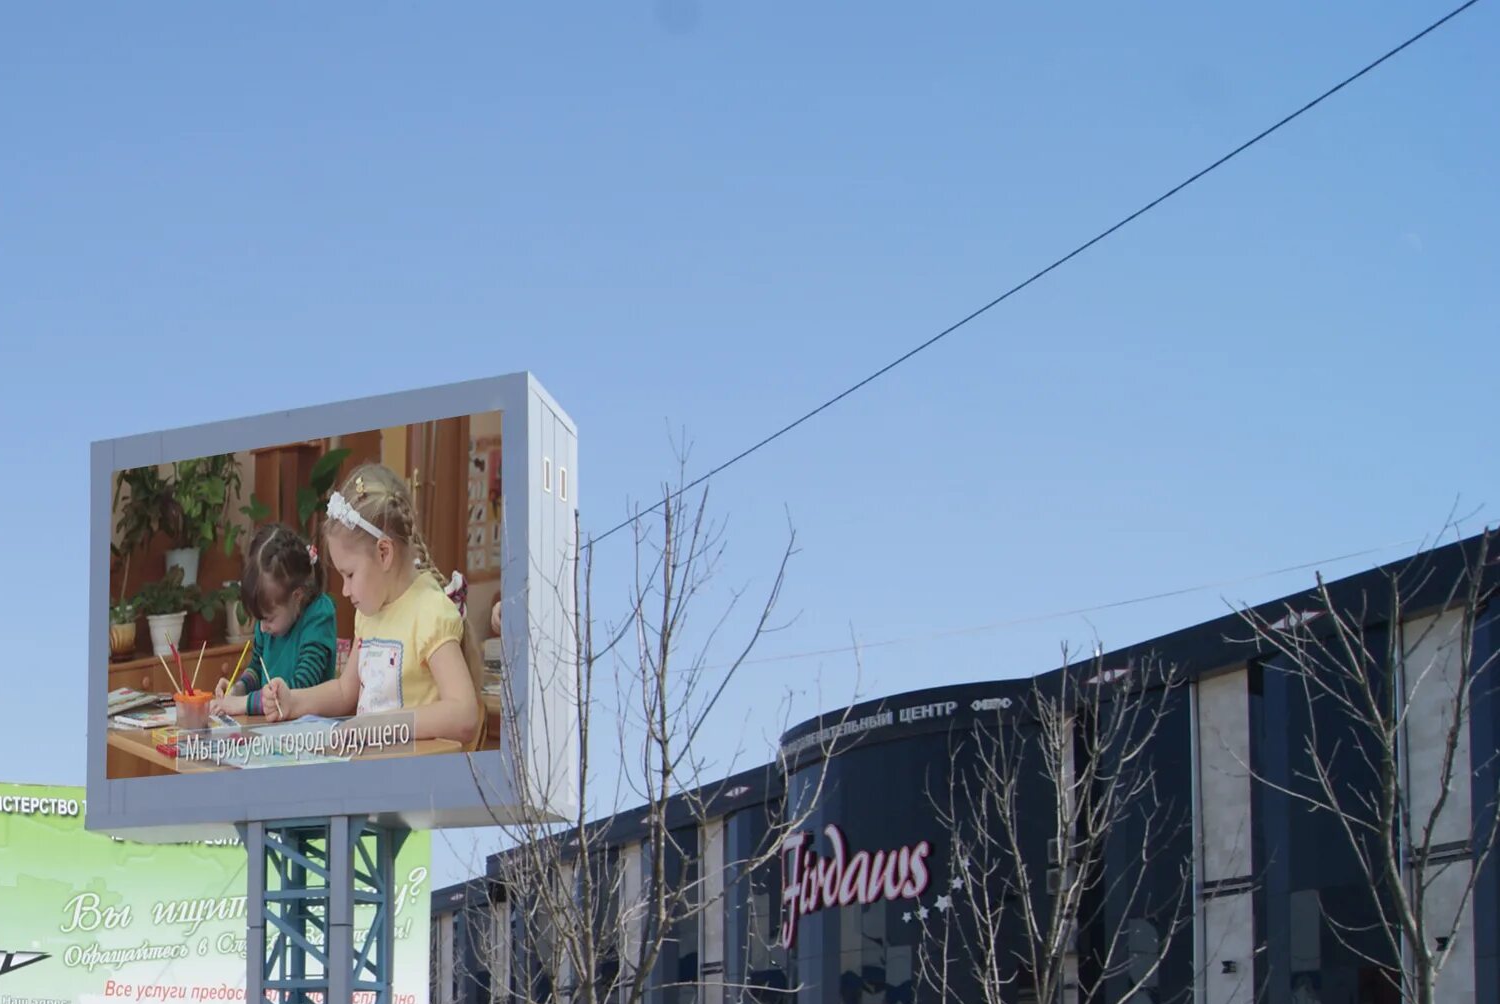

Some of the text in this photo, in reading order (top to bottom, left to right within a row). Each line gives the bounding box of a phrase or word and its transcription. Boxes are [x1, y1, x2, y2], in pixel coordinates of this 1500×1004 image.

[899, 701, 958, 723] ЦЕНТР
[185, 721, 410, 765] Мы рисуем город будущего
[782, 824, 930, 950] Firdaws
[60, 892, 250, 936] Вы ищит
[63, 941, 189, 972] Обращайтесь
[197, 937, 209, 955] в
[104, 980, 132, 997] Все
[136, 983, 187, 1002] услуги
